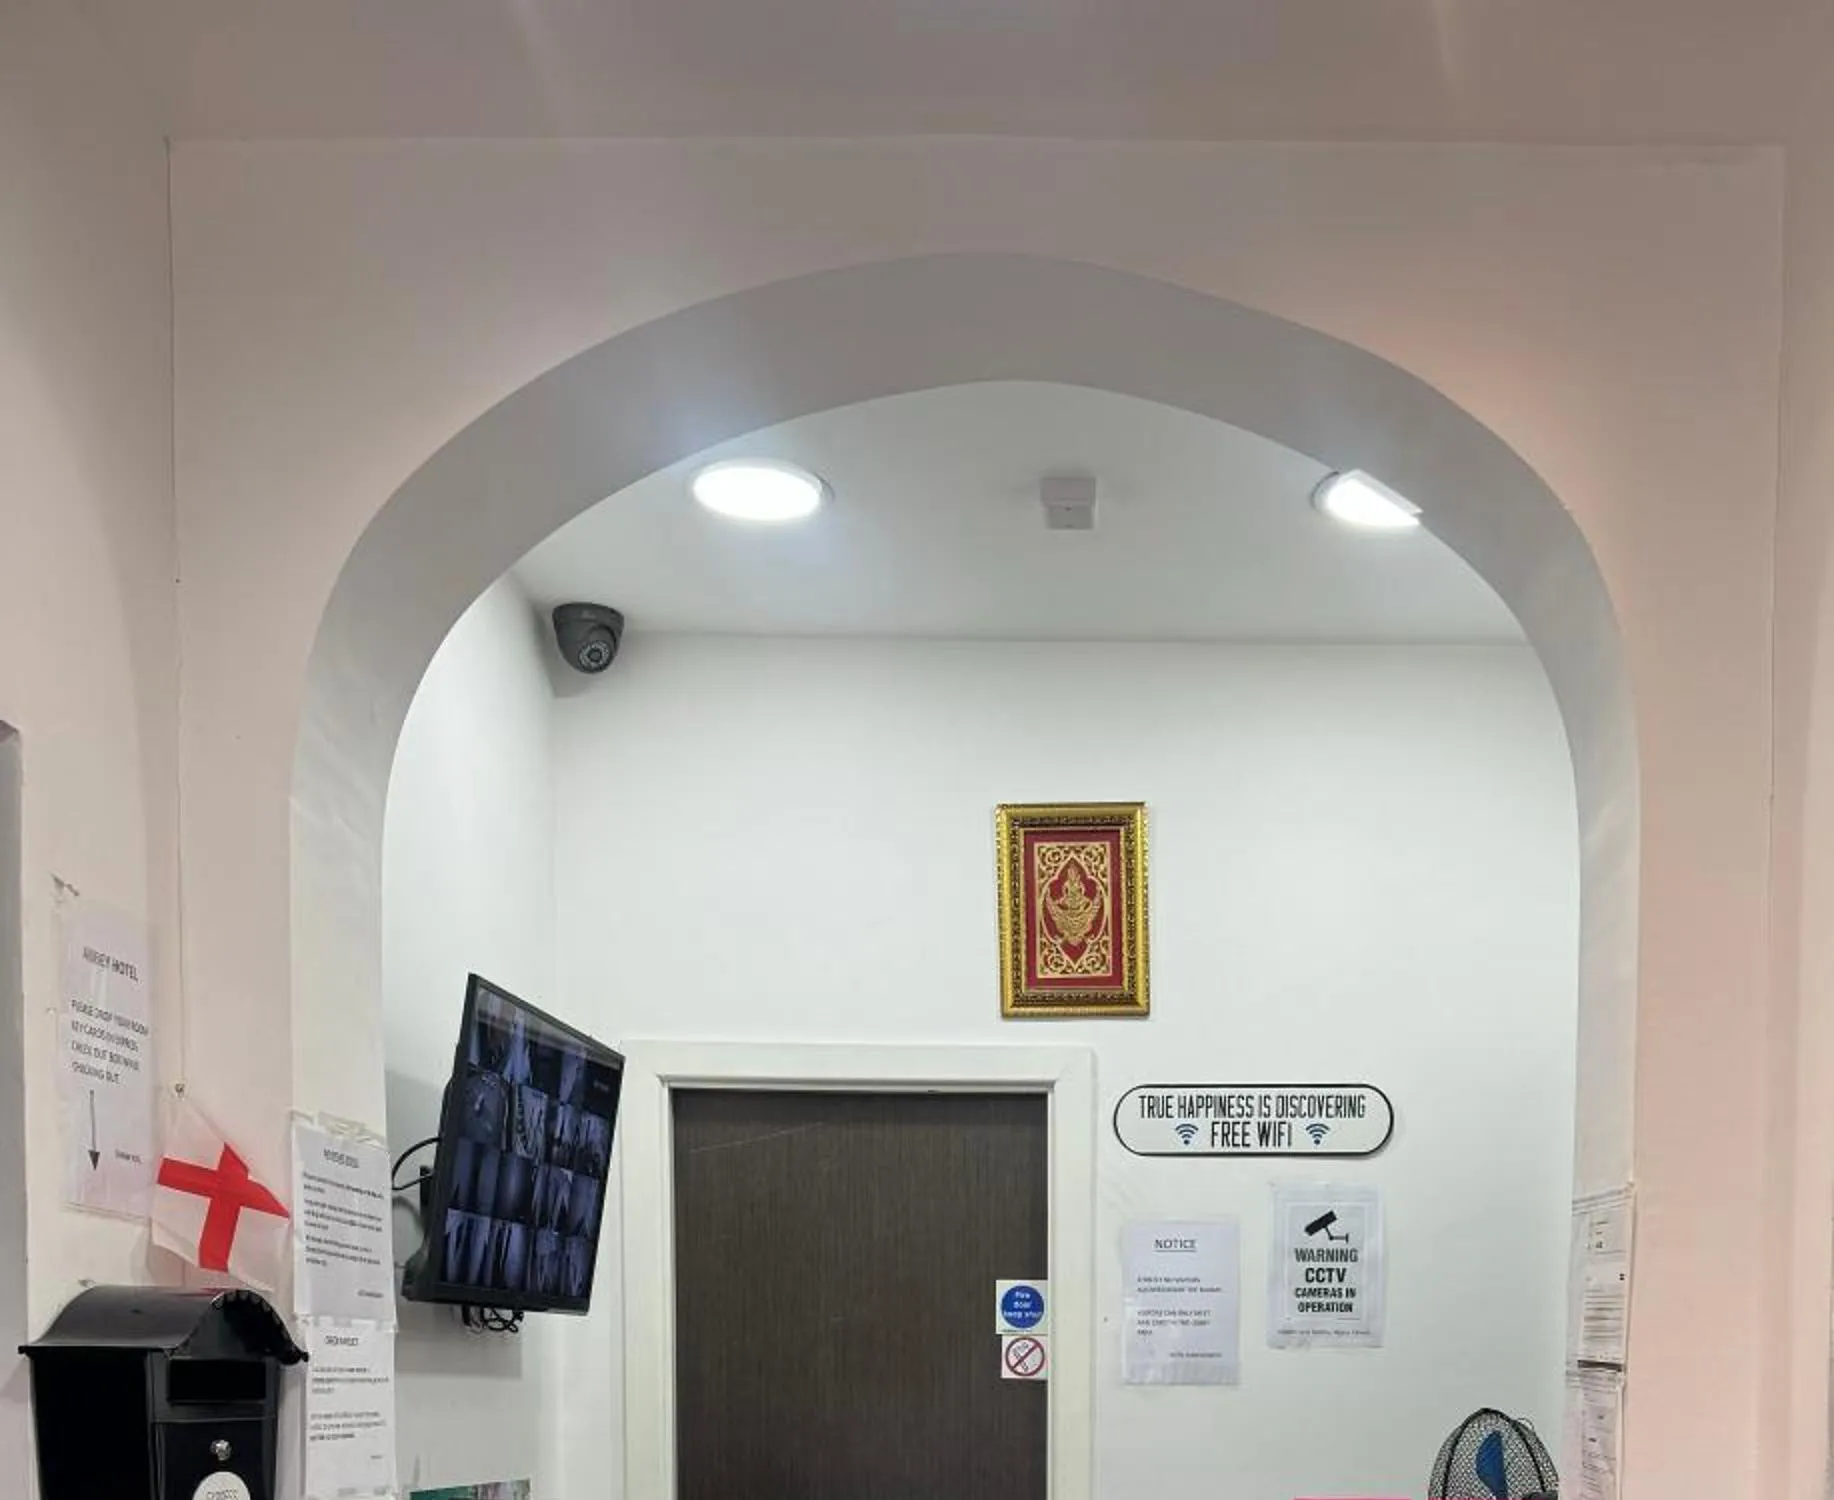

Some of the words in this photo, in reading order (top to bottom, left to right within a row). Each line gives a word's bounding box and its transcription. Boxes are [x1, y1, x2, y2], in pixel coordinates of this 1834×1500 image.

[111, 957, 139, 982] HOTEL
[1138, 1095, 1174, 1119] TRUE
[1177, 1095, 1255, 1119] HAPPINESS
[1258, 1095, 1272, 1119] IS
[1275, 1095, 1367, 1119] DISCOVERING
[1210, 1121, 1252, 1148] FREE
[1257, 1121, 1293, 1148] WIFI
[1154, 1239, 1197, 1249] NOTICE
[1294, 1248, 1360, 1263] WARNING
[1304, 1267, 1348, 1284] CCTV
[1294, 1288, 1343, 1299] CAMERAS
[1345, 1288, 1357, 1299] IN
[1297, 1302, 1354, 1313] OPERATION
